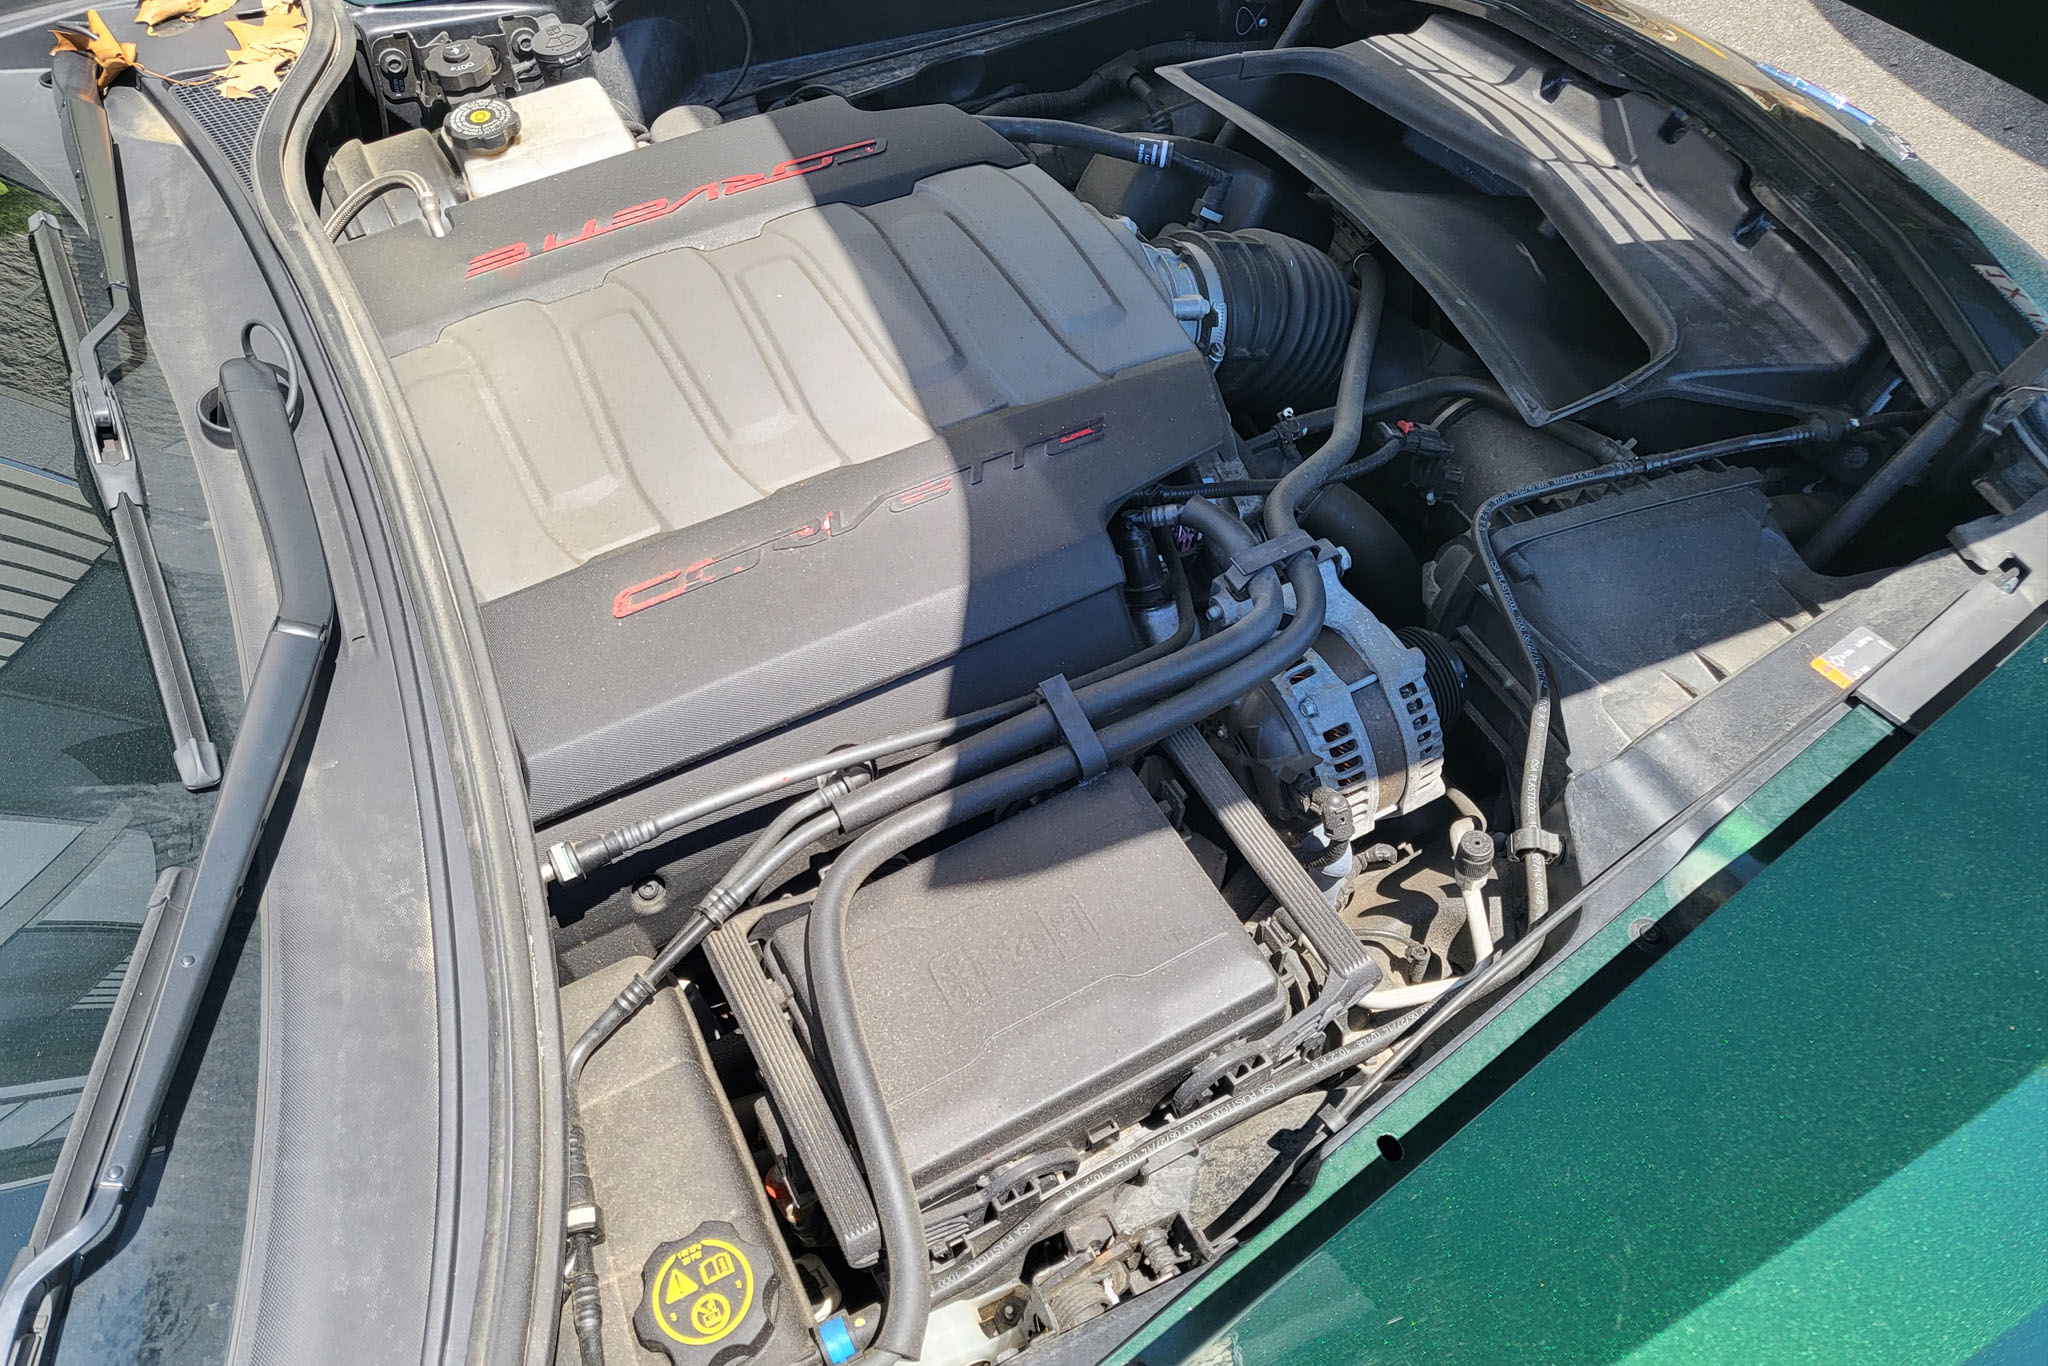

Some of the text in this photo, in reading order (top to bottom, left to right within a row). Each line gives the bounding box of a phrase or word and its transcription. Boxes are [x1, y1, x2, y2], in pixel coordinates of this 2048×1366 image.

[465, 137, 888, 279] CORVETTE
[612, 416, 1105, 619] CORVETTE
[1489, 559, 1499, 572] CSA
[1495, 573, 1519, 613] PLASTICOOL
[1514, 614, 1527, 632] 1000
[1521, 632, 1542, 665] 06/27/14
[1529, 758, 1539, 772] CSA
[1528, 774, 1538, 817] PLASTICOOL
[1310, 1060, 1319, 1070] 8
[1257, 1081, 1275, 1095] CSA
[1206, 1090, 1257, 1121] PLASTICOOL
[1182, 1117, 1205, 1133] 1000
[1139, 1129, 1181, 1156] 06/27/14
[1082, 1170, 1105, 1187] 10.2
[1063, 1189, 1073, 1198] 8
[936, 1220, 1032, 1289] CSA PLASTICOOL 1000
